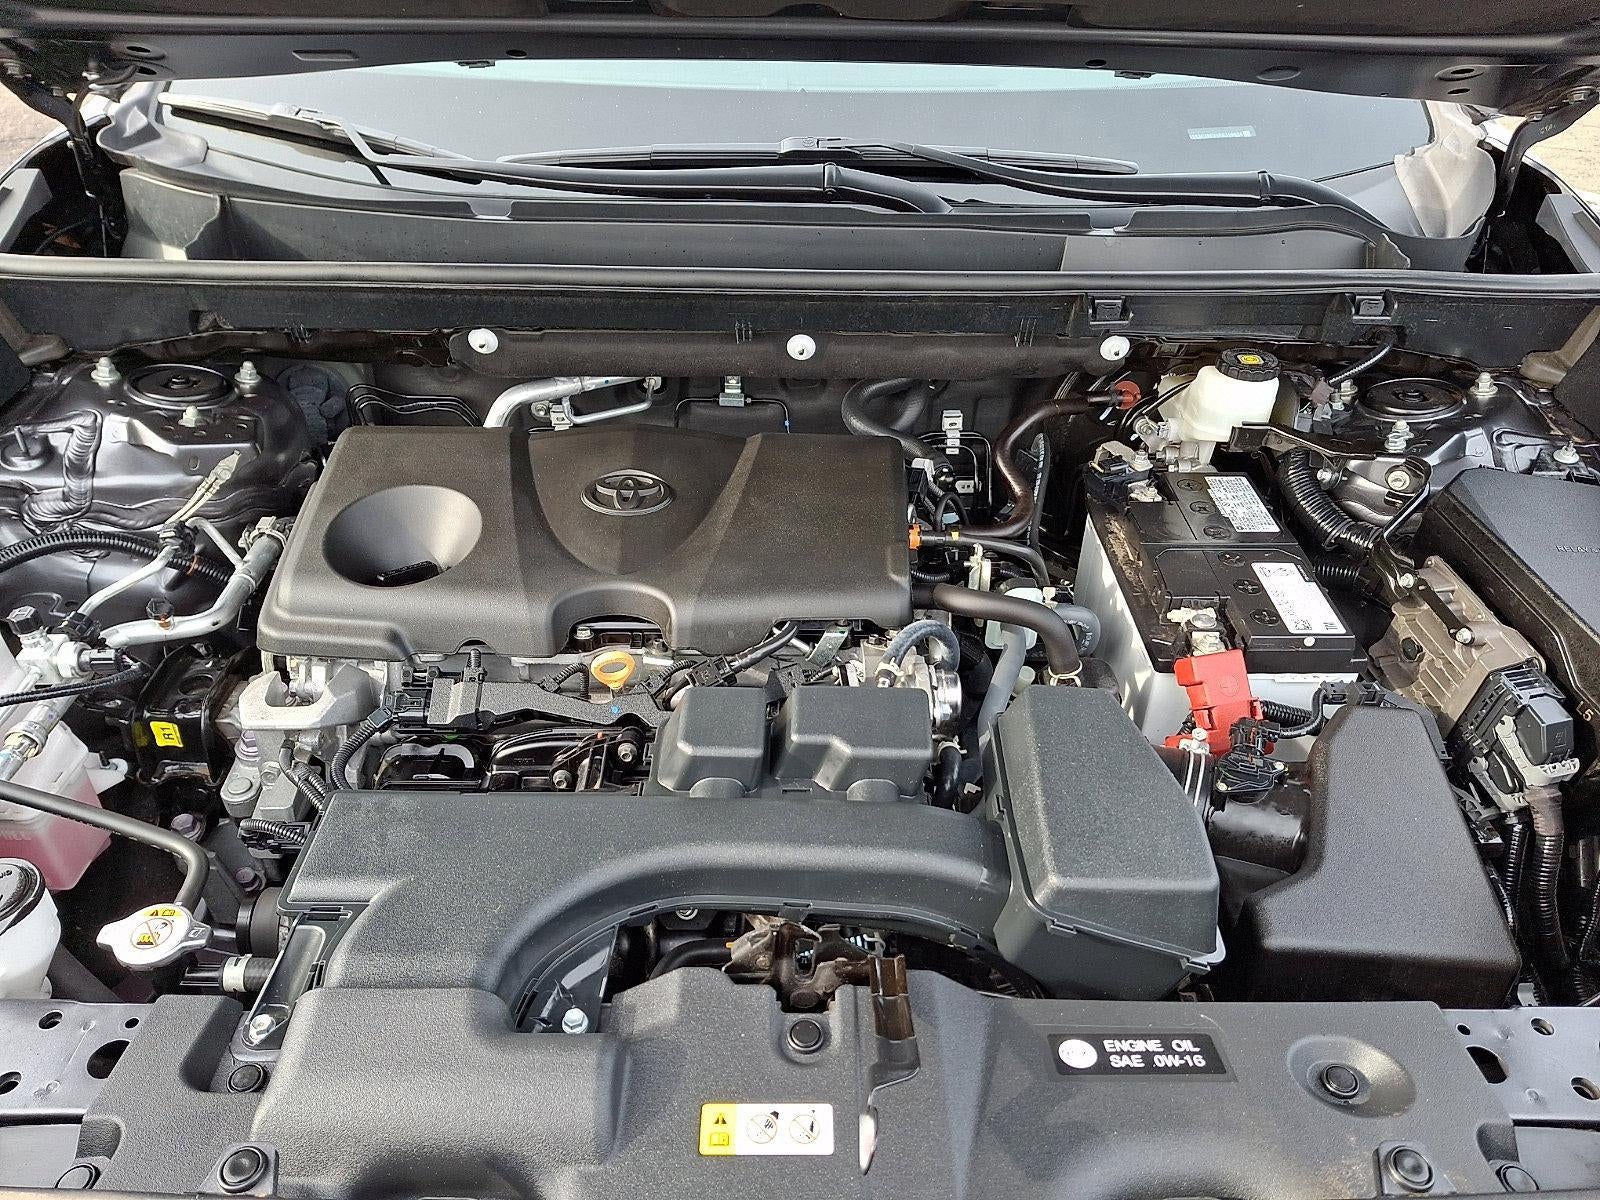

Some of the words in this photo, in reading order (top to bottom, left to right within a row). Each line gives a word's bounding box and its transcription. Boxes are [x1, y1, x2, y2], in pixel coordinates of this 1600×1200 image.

[160, 727, 175, 740] R1
[1102, 1039, 1164, 1052] ENGINE
[1171, 1039, 1201, 1052] OIL
[1109, 1055, 1145, 1068] SAE
[1154, 1055, 1206, 1068] 0W-16
